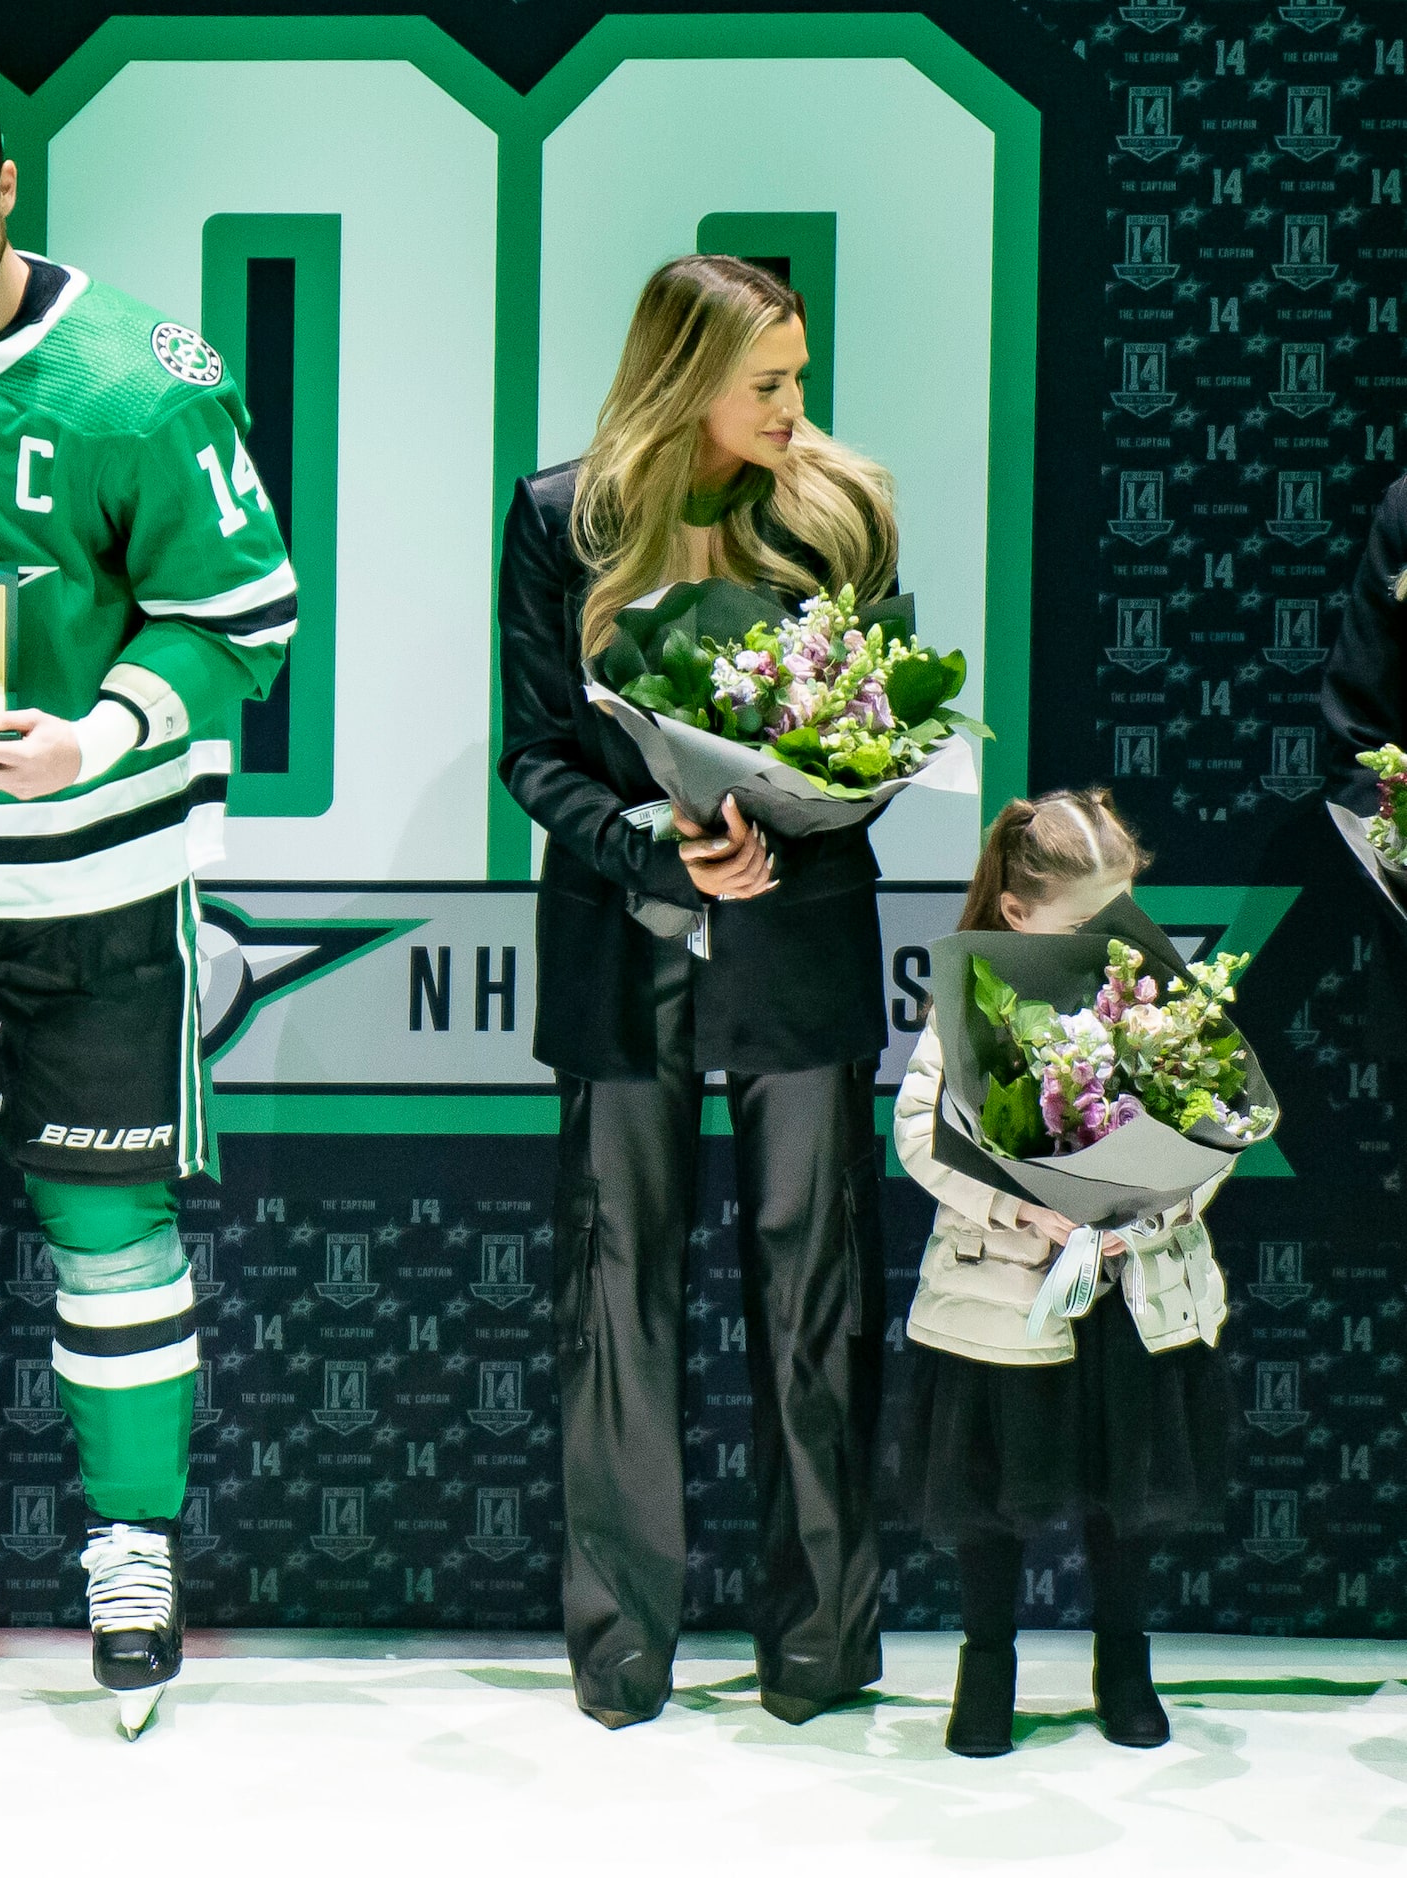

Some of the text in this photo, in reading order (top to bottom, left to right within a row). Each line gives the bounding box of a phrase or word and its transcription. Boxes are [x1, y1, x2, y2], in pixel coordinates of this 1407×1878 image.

[1215, 39, 1245, 75] 14
[1283, 52, 1338, 62] THE CAPTAIN
[1375, 39, 1403, 74] 14
[1134, 97, 1165, 134] 14
[1202, 120, 1257, 130] THE CAPTAIN
[1293, 97, 1322, 134] 14
[1212, 168, 1242, 204] 14
[1371, 168, 1401, 204] 14
[1131, 225, 1162, 262] 14
[1290, 226, 1319, 263] 14
[1119, 310, 1174, 320] THE CAPTAIN
[1209, 296, 1239, 332] 14
[1368, 297, 1398, 332] 14
[1129, 354, 1158, 391] 14
[1287, 354, 1316, 391] 14
[1206, 424, 1236, 460] 14
[1366, 425, 1394, 460] 14
[17, 435, 54, 513] C
[196, 426, 269, 538] 14
[1126, 482, 1155, 519] 14
[1284, 482, 1313, 519] 14
[1203, 552, 1233, 588] 14
[1123, 609, 1154, 646] 14
[1190, 632, 1245, 642] THE CAPTAIN
[1110, 693, 1165, 703] THE CAPTAIN
[1202, 680, 1230, 715] 14
[1122, 738, 1152, 774] 14
[1278, 737, 1307, 774] 14
[410, 946, 516, 1031] NH
[1350, 1063, 1378, 1098] 14
[39, 1123, 174, 1150] BAUER
[321, 1200, 376, 1210] THE CAPTAIN
[476, 1201, 531, 1211] THE CAPTAIN
[242, 1266, 297, 1276] THE CAPTAIN
[332, 1244, 361, 1281] 14
[397, 1267, 452, 1277] THE CAPTAIN
[487, 1245, 516, 1282] 14
[1265, 1246, 1296, 1283] 14
[1331, 1268, 1386, 1278] THE CAPTAIN
[253, 1314, 283, 1350] 14
[319, 1328, 374, 1338] THE CAPTAIN
[408, 1315, 438, 1351] 14
[474, 1329, 529, 1339] THE CAPTAIN
[1342, 1316, 1372, 1352] 14
[21, 1370, 50, 1407] 14
[330, 1372, 361, 1409] 14
[485, 1372, 514, 1409] 14
[1262, 1372, 1291, 1409] 14
[251, 1441, 281, 1476] 14
[406, 1442, 436, 1477] 14
[717, 1443, 747, 1478] 14
[1340, 1445, 1370, 1480] 14
[18, 1496, 49, 1533] 14
[327, 1497, 358, 1534] 14
[1026, 1569, 1054, 1604] 14
[1337, 1571, 1367, 1607] 14
